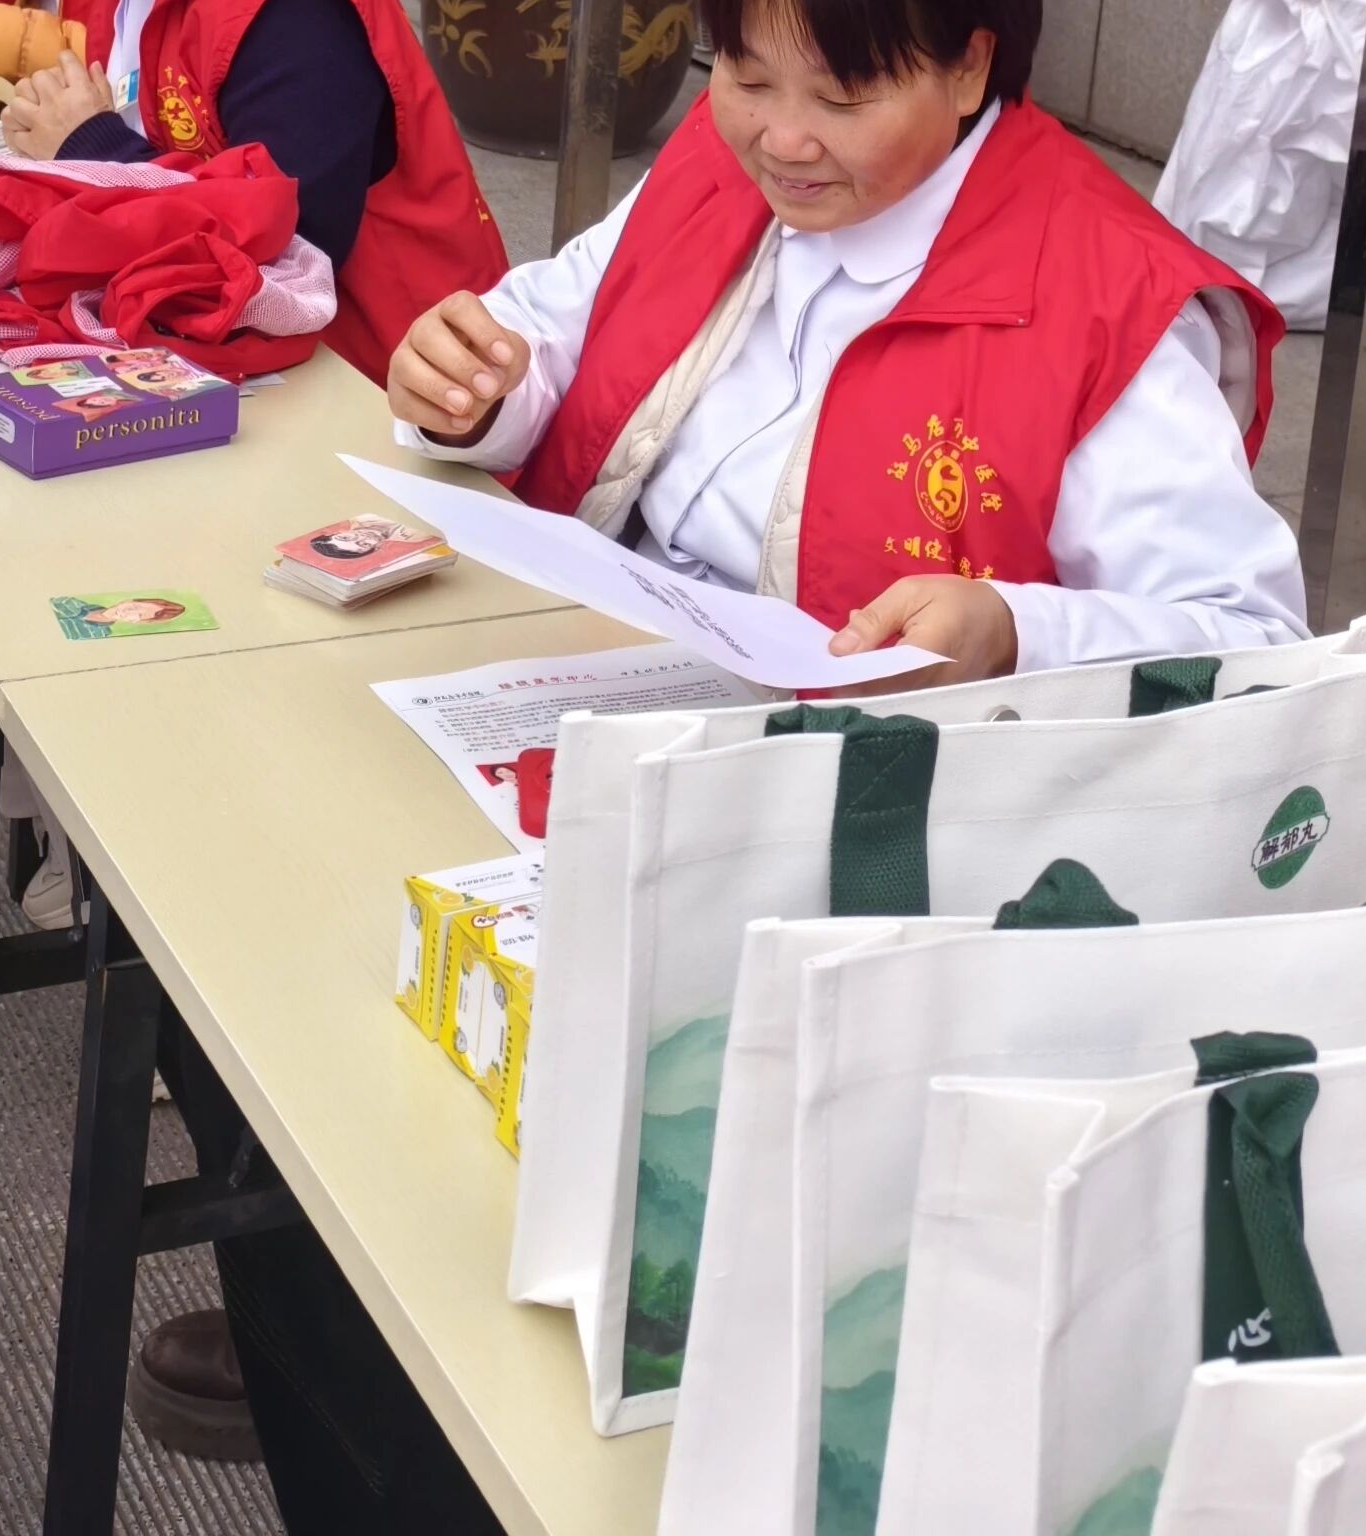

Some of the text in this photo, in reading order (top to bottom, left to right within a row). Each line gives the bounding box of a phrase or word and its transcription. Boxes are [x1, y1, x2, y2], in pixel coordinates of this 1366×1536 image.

[75, 406, 201, 449] personita
[1259, 818, 1318, 865] 解郁丸
